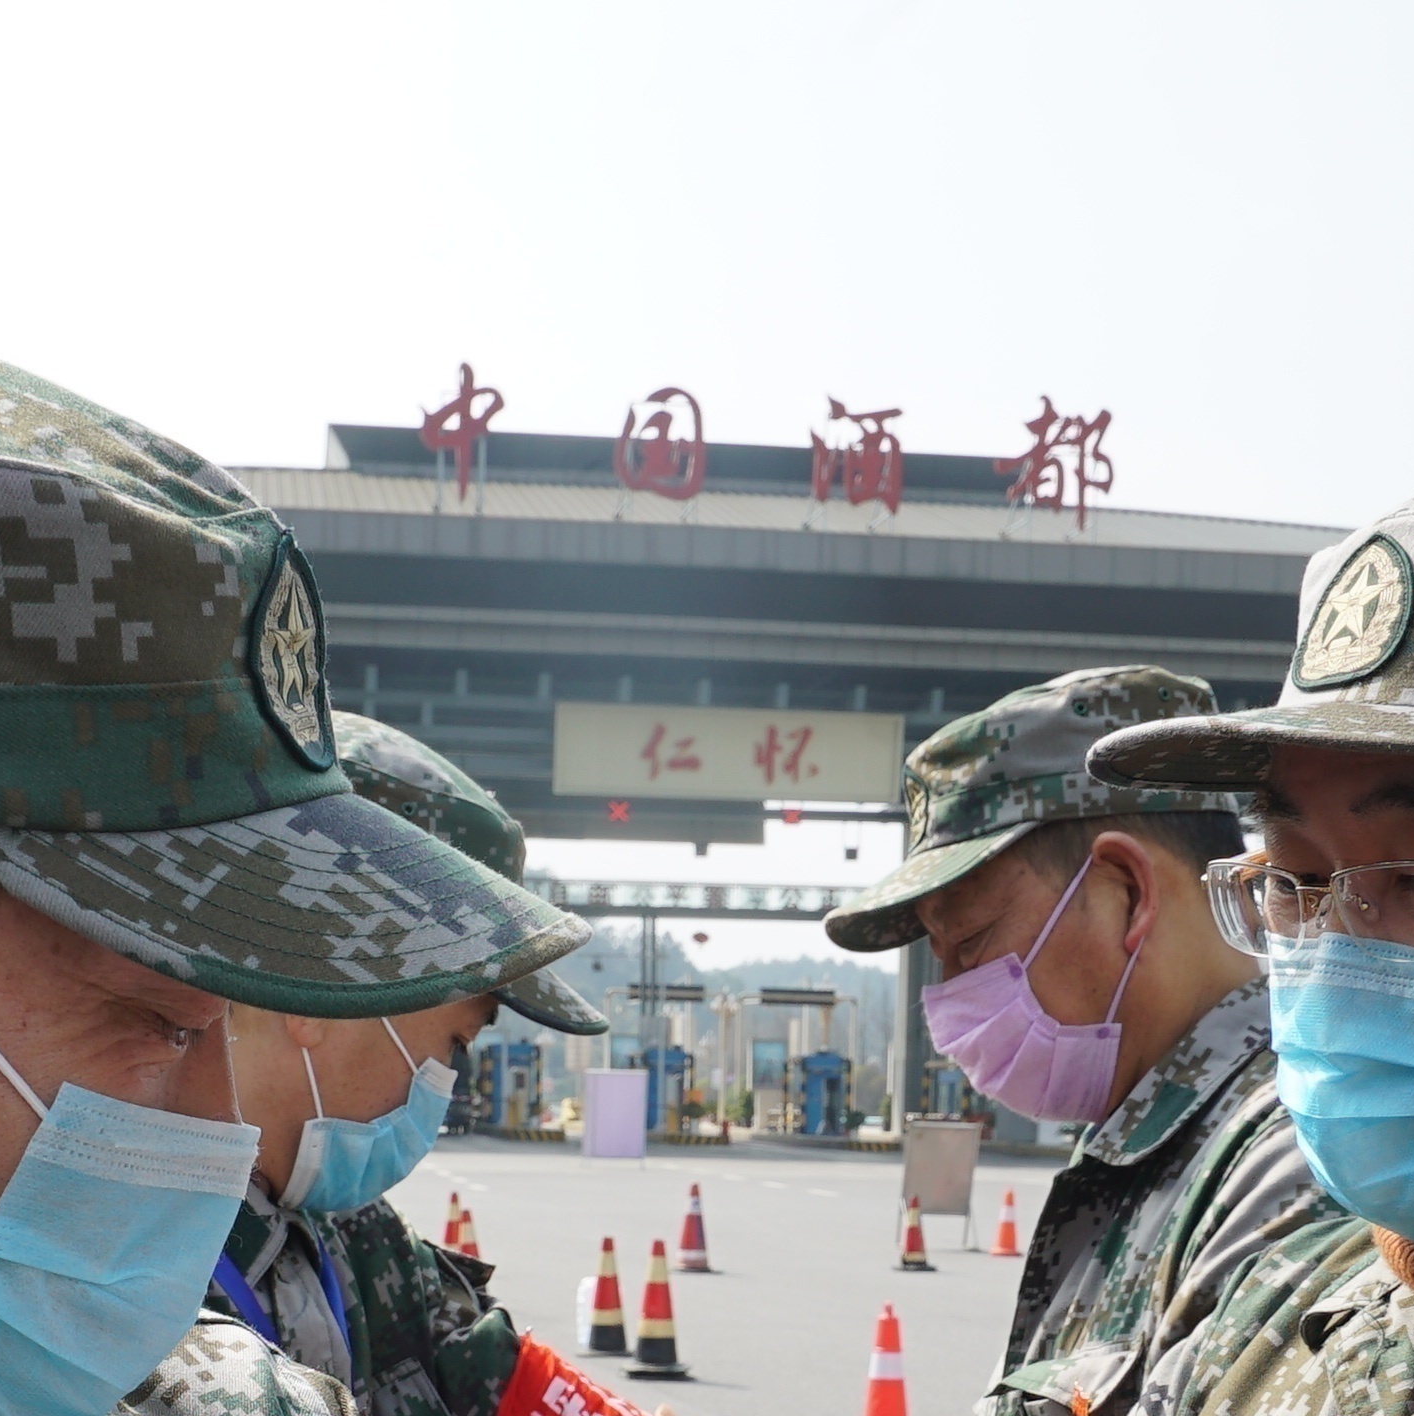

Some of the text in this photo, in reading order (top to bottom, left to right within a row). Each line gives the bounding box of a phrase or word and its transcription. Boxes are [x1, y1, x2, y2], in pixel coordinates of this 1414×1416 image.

[418, 362, 1113, 531] 中国酒都
[641, 723, 819, 784] 仁怀
